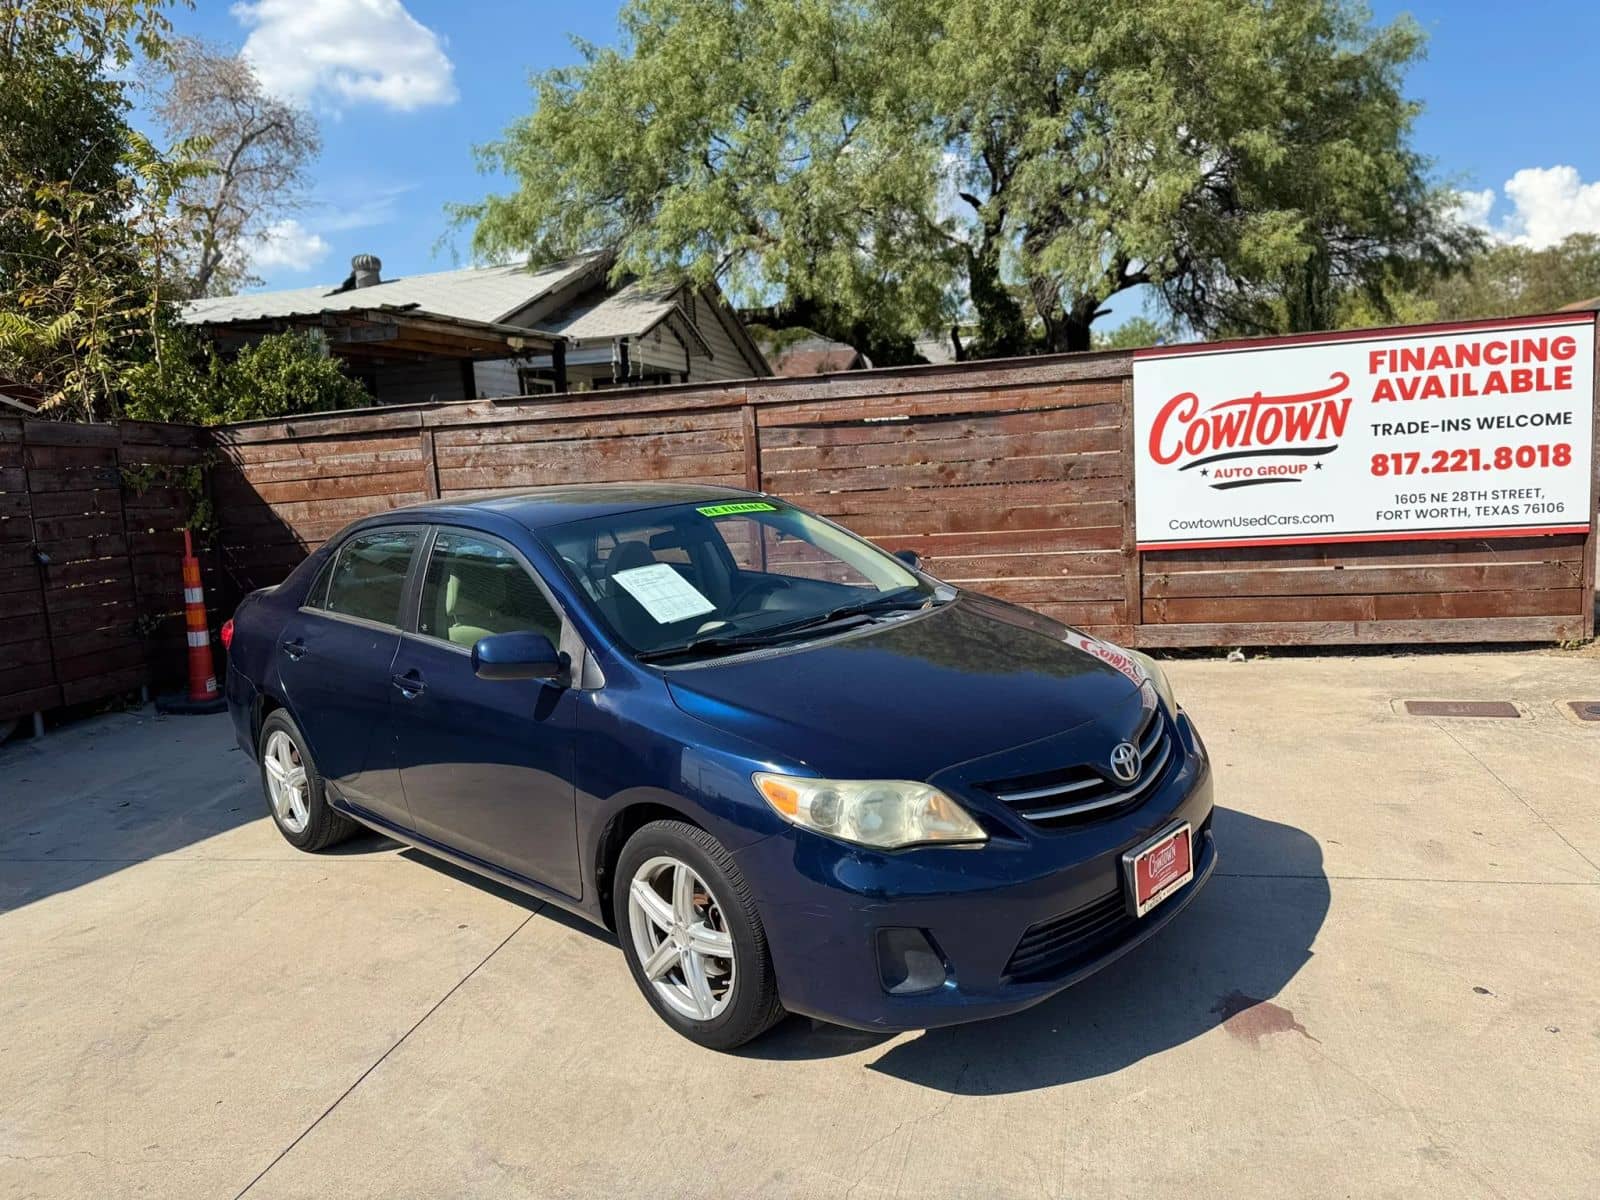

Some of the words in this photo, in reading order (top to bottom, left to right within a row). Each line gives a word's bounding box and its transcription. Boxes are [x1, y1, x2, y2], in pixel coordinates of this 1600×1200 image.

[1369, 336, 1577, 375] FINANCING
[1371, 365, 1573, 403] AVAILABLE
[1148, 371, 1353, 465] COWTOWN
[1370, 416, 1473, 437] TRADE-INS
[1476, 412, 1573, 432] WELCOME
[1214, 467, 1253, 479] AUTO
[1257, 464, 1308, 477] GROUP
[1370, 443, 1572, 477] 817.221.8018
[1394, 493, 1427, 505] 1605
[1430, 492, 1449, 503] NE
[1452, 490, 1488, 502] 28TH
[1491, 487, 1545, 501] STREET,
[1168, 514, 1335, 530] CowtownUsedCars.com
[1376, 509, 1411, 521] FORT
[1414, 507, 1472, 520] WORTH,
[1475, 504, 1520, 517] TEXAS
[1523, 502, 1565, 514] 76106
